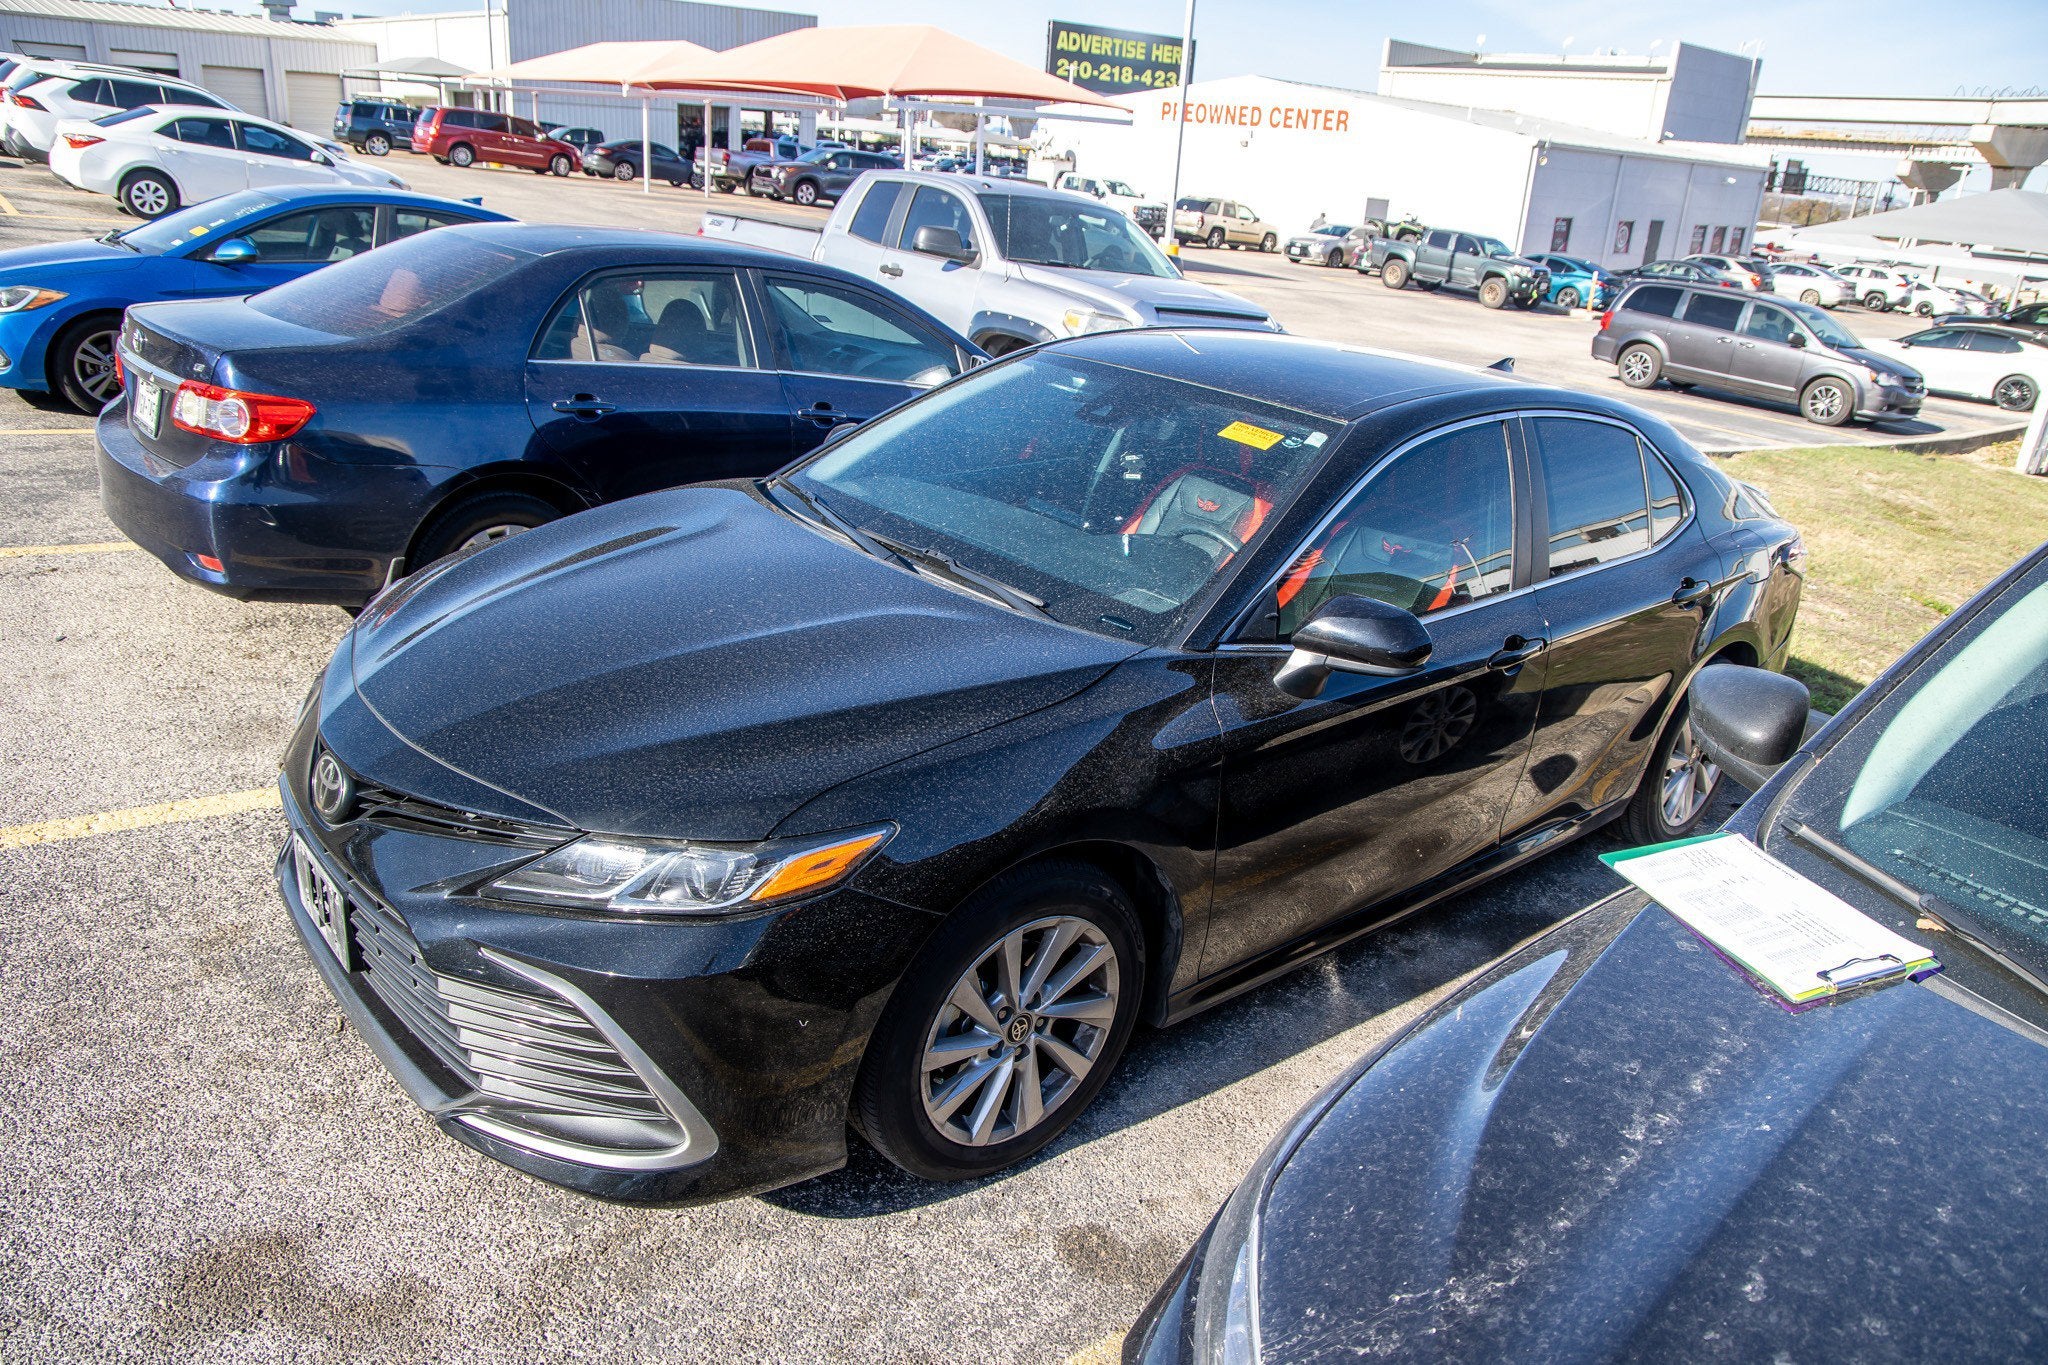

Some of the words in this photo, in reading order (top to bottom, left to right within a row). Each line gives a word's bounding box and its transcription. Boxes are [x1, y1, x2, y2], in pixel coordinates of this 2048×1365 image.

[1056, 30, 1147, 61] ADVERTISE
[1151, 43, 1182, 65] HER
[1056, 57, 1178, 88] 210-218-423
[1269, 106, 1349, 131] CENTER
